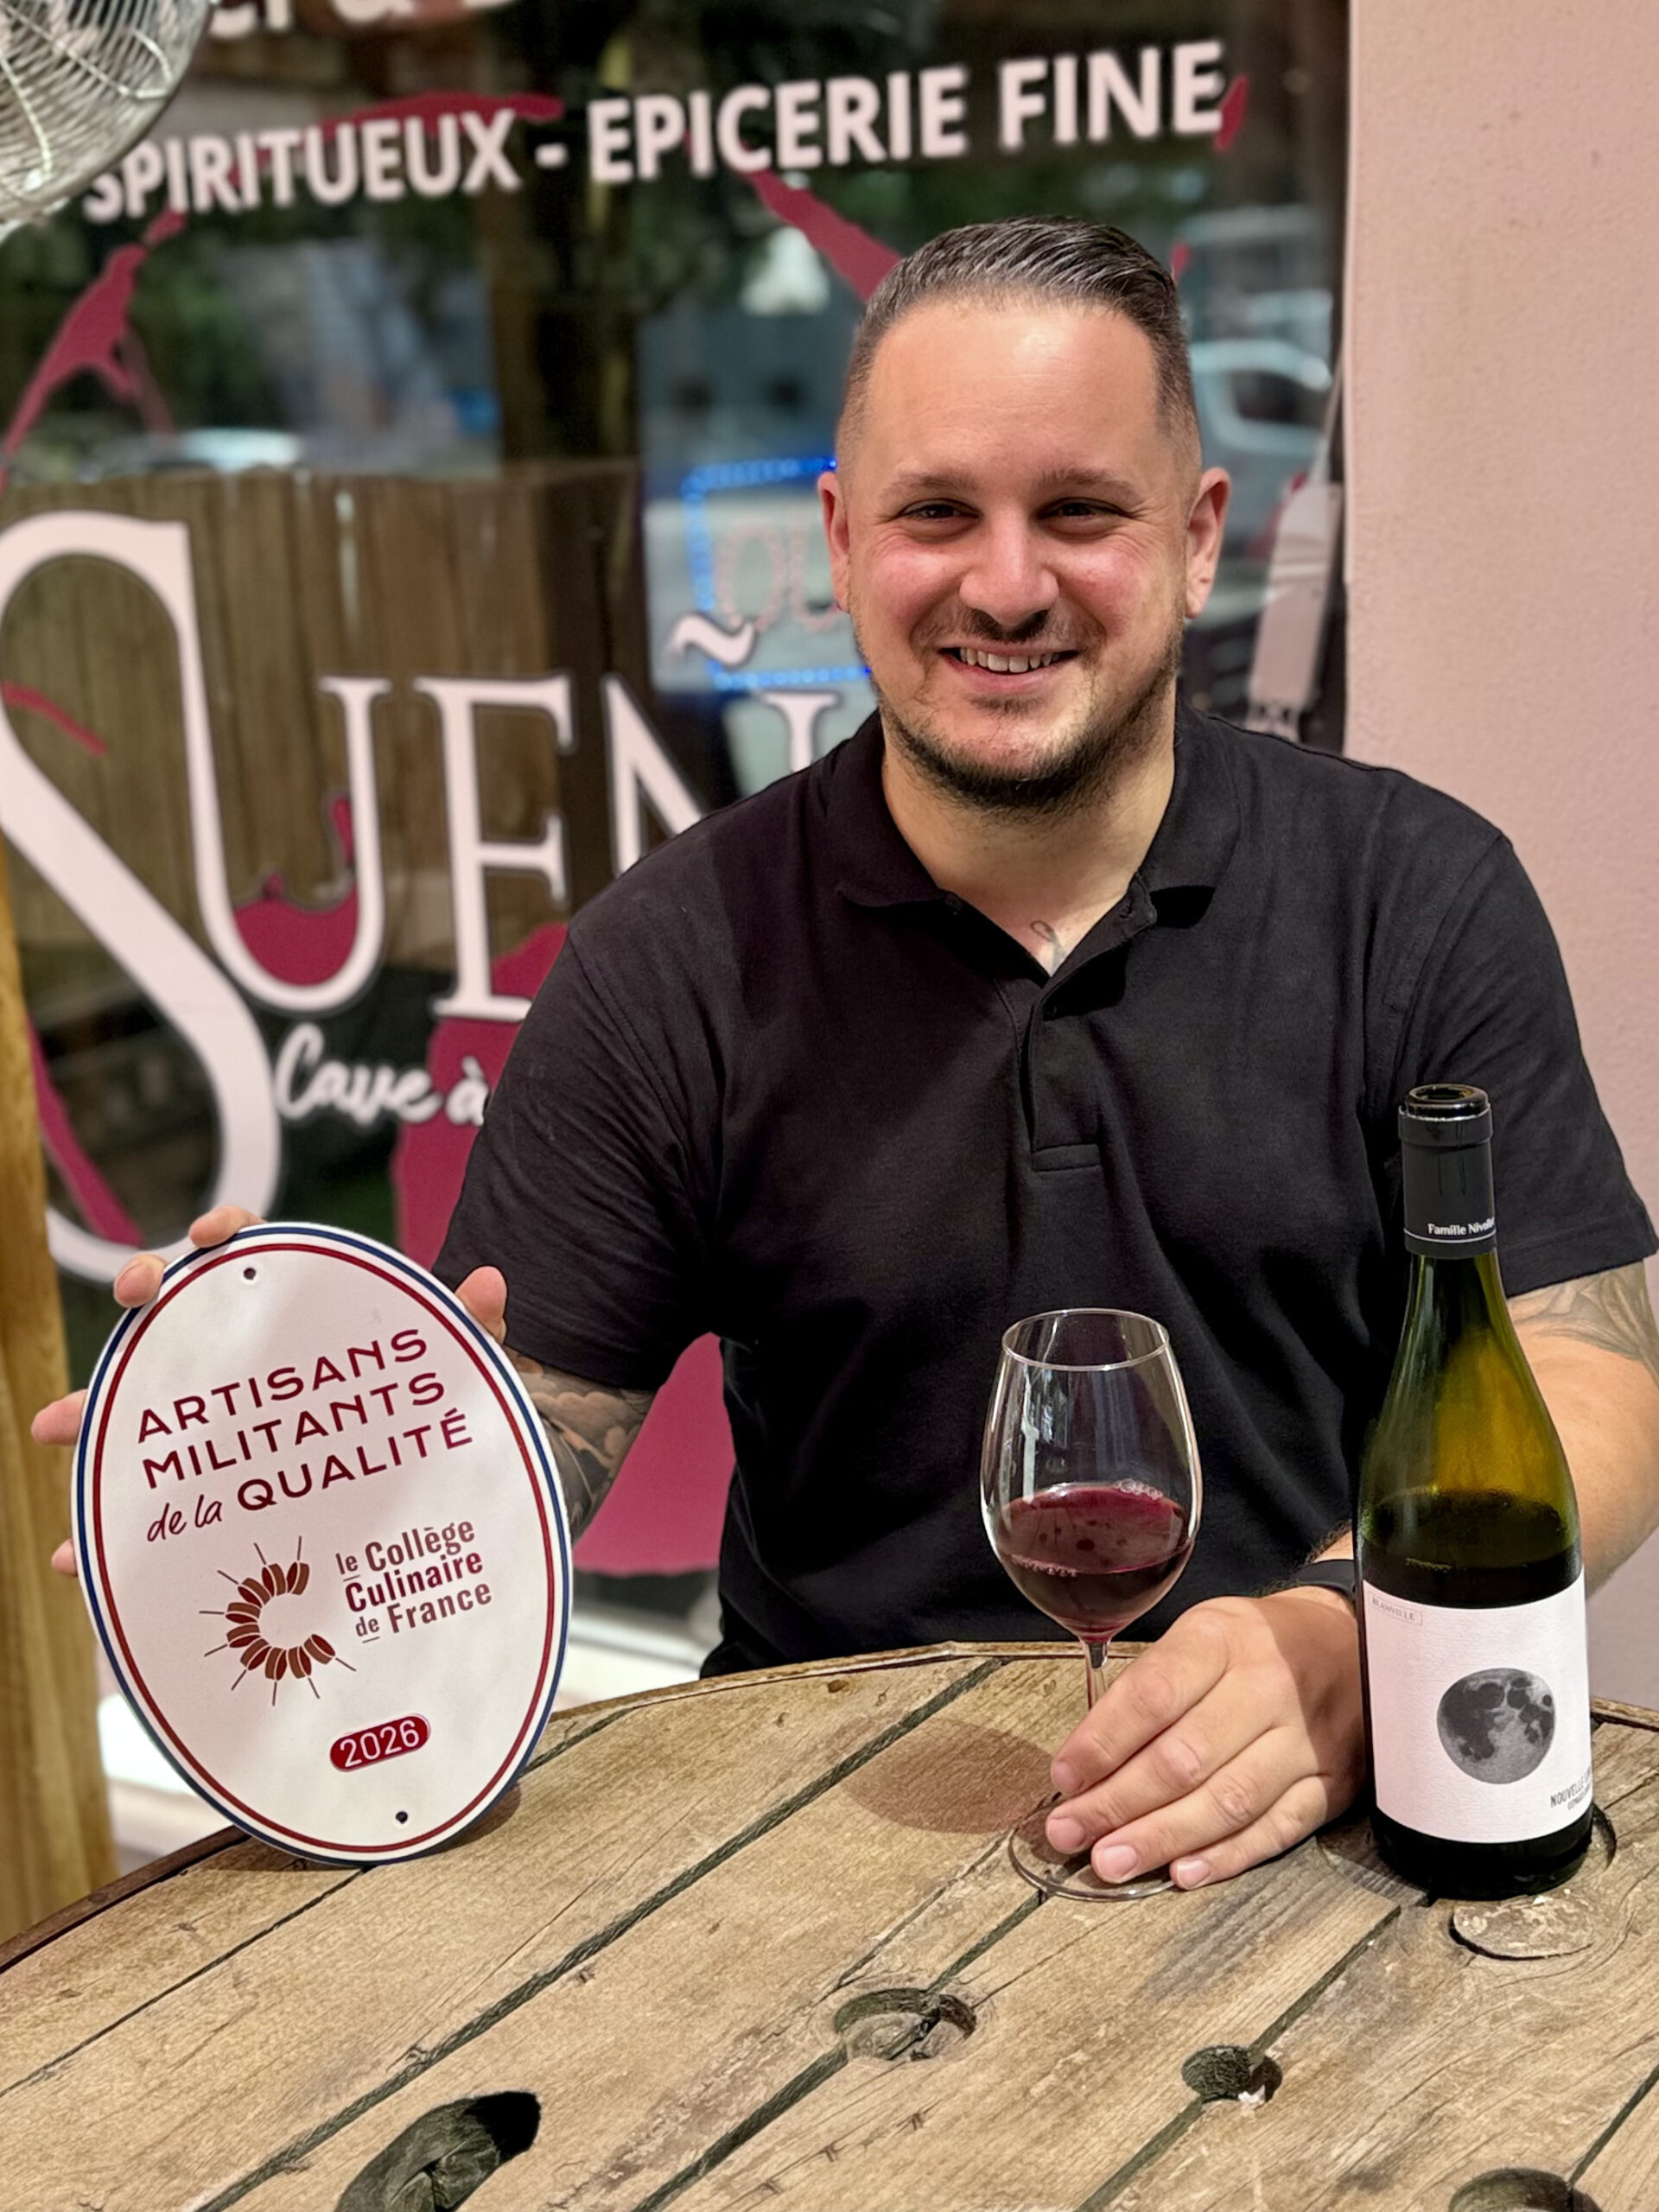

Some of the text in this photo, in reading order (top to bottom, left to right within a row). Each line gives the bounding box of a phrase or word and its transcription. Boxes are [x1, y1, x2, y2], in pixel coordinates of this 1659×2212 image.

[84, 108, 522, 223] SPIRITUEUX
[588, 65, 968, 183] EPICERIE
[998, 41, 1224, 149] FINE
[275, 1023, 443, 1126] Cave
[1427, 1223, 1466, 1236] Famille
[138, 1329, 427, 1444] ARTISANS
[143, 1372, 445, 1490] MILITANTS
[146, 1408, 473, 1542] de la QUALITÉ
[335, 1521, 475, 1576] le Collège
[345, 1552, 484, 1613] Culinaire
[355, 1583, 492, 1637] de France
[340, 1719, 420, 1768] 2026
[1550, 1776, 1584, 1808] NOUVELLE
